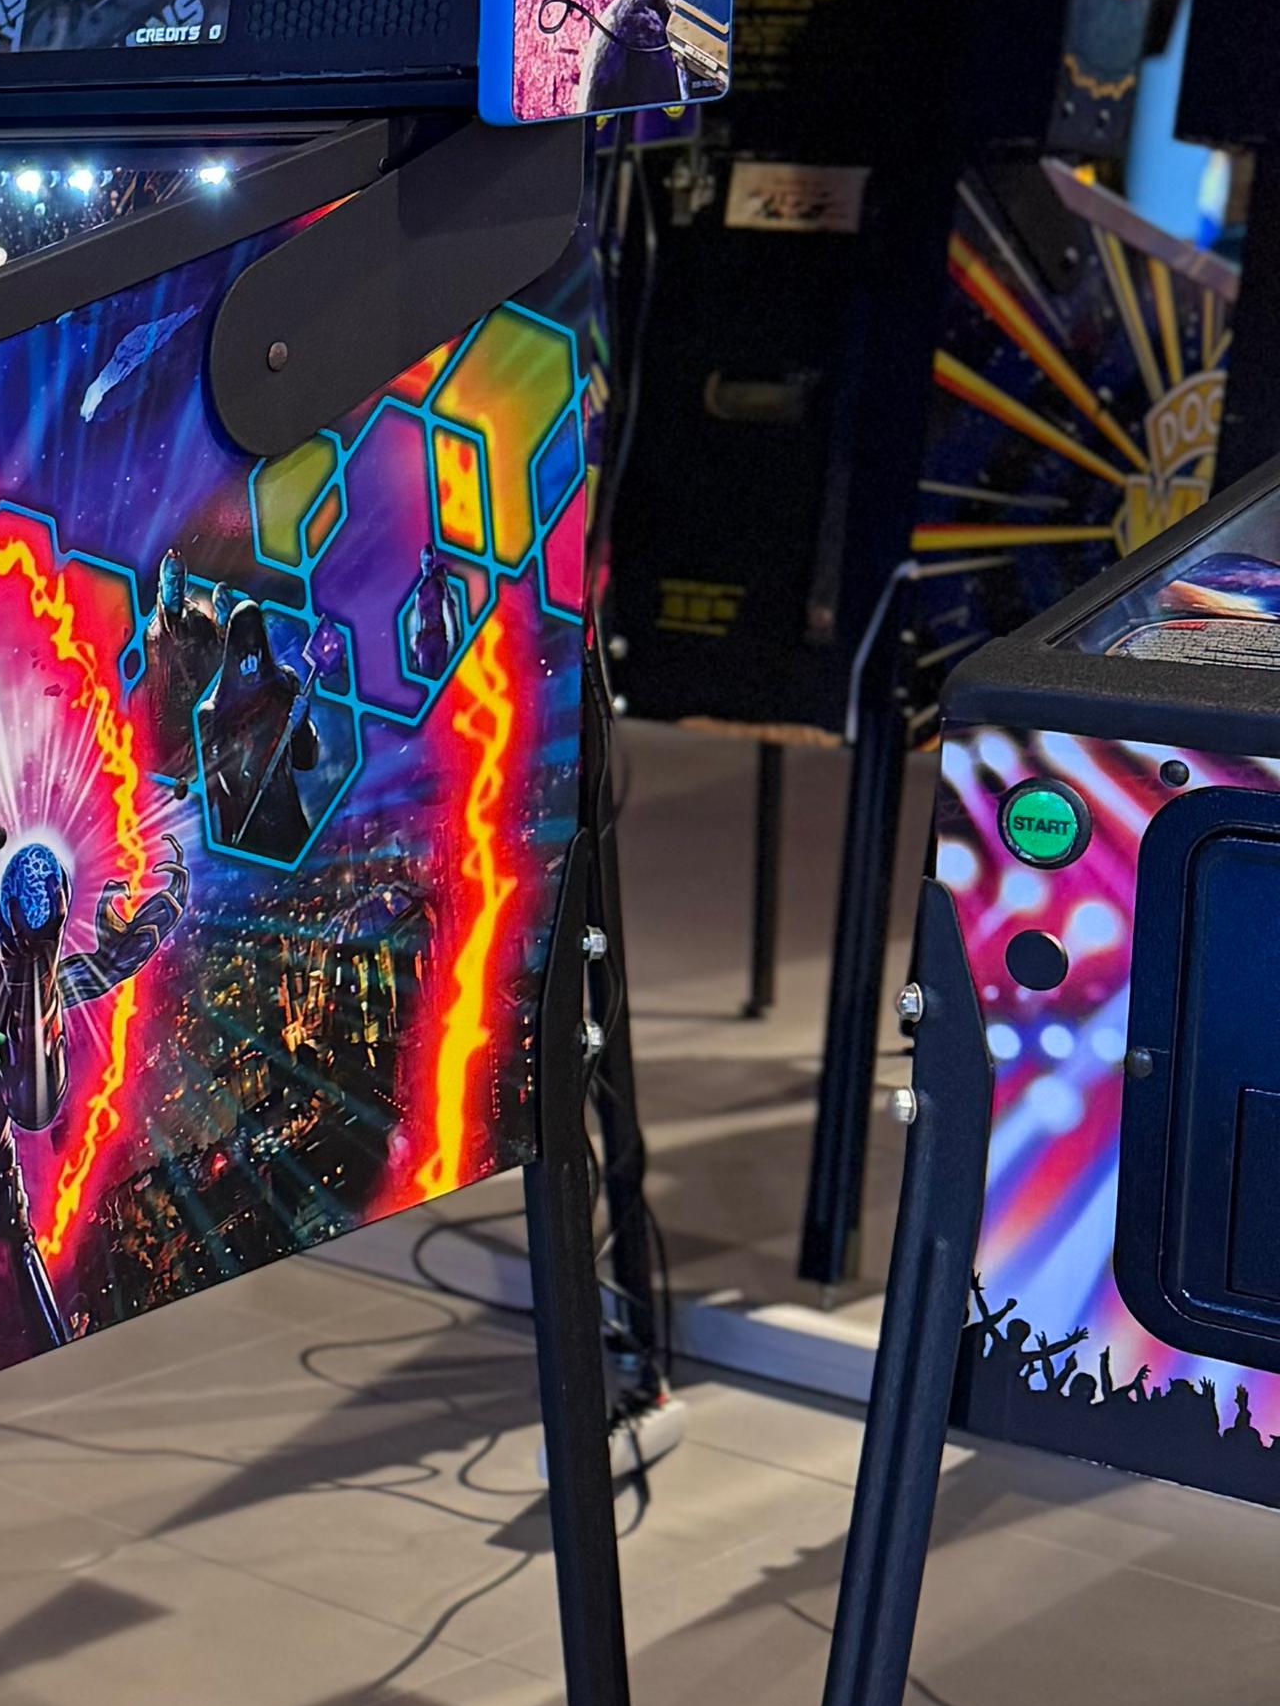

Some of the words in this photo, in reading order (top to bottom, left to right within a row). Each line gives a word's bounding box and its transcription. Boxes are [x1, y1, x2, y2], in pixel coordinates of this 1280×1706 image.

[135, 24, 202, 44] CREDITS
[208, 24, 222, 40] 0
[1012, 815, 1072, 836] START
